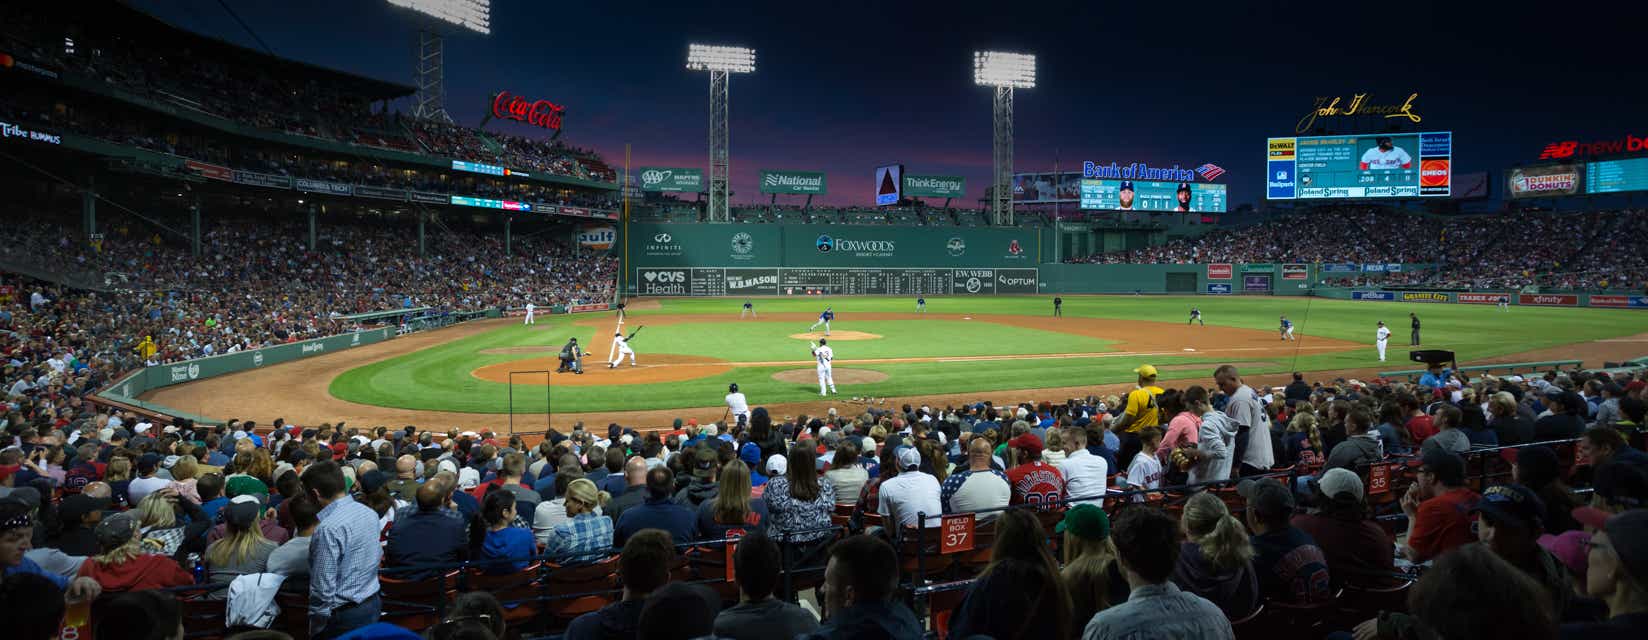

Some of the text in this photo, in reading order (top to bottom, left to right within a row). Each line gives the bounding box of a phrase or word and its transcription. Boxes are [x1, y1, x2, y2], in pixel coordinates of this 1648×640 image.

[493, 91, 565, 130] Coca-Cola
[1296, 93, 1422, 134] John Hancock
[0, 121, 28, 138] Tribe
[1579, 138, 1623, 157] new
[643, 170, 663, 183] AAA
[1083, 161, 1194, 181] Bank of America
[779, 176, 822, 187] National
[1530, 181, 1572, 190] DONUTS
[1298, 187, 1350, 196] Poland Spring
[1364, 186, 1417, 196] Poland Spring
[835, 239, 894, 251] FOXWOODS
[657, 271, 686, 283] CVS
[971, 270, 992, 278] WEBB
[1006, 278, 1035, 286] OPTUM
[646, 283, 685, 295] Health
[1534, 296, 1563, 304] xfinity
[1372, 478, 1386, 489] 35
[946, 517, 969, 526] FIELD
[949, 524, 966, 533] BOX
[946, 532, 968, 546] 37
